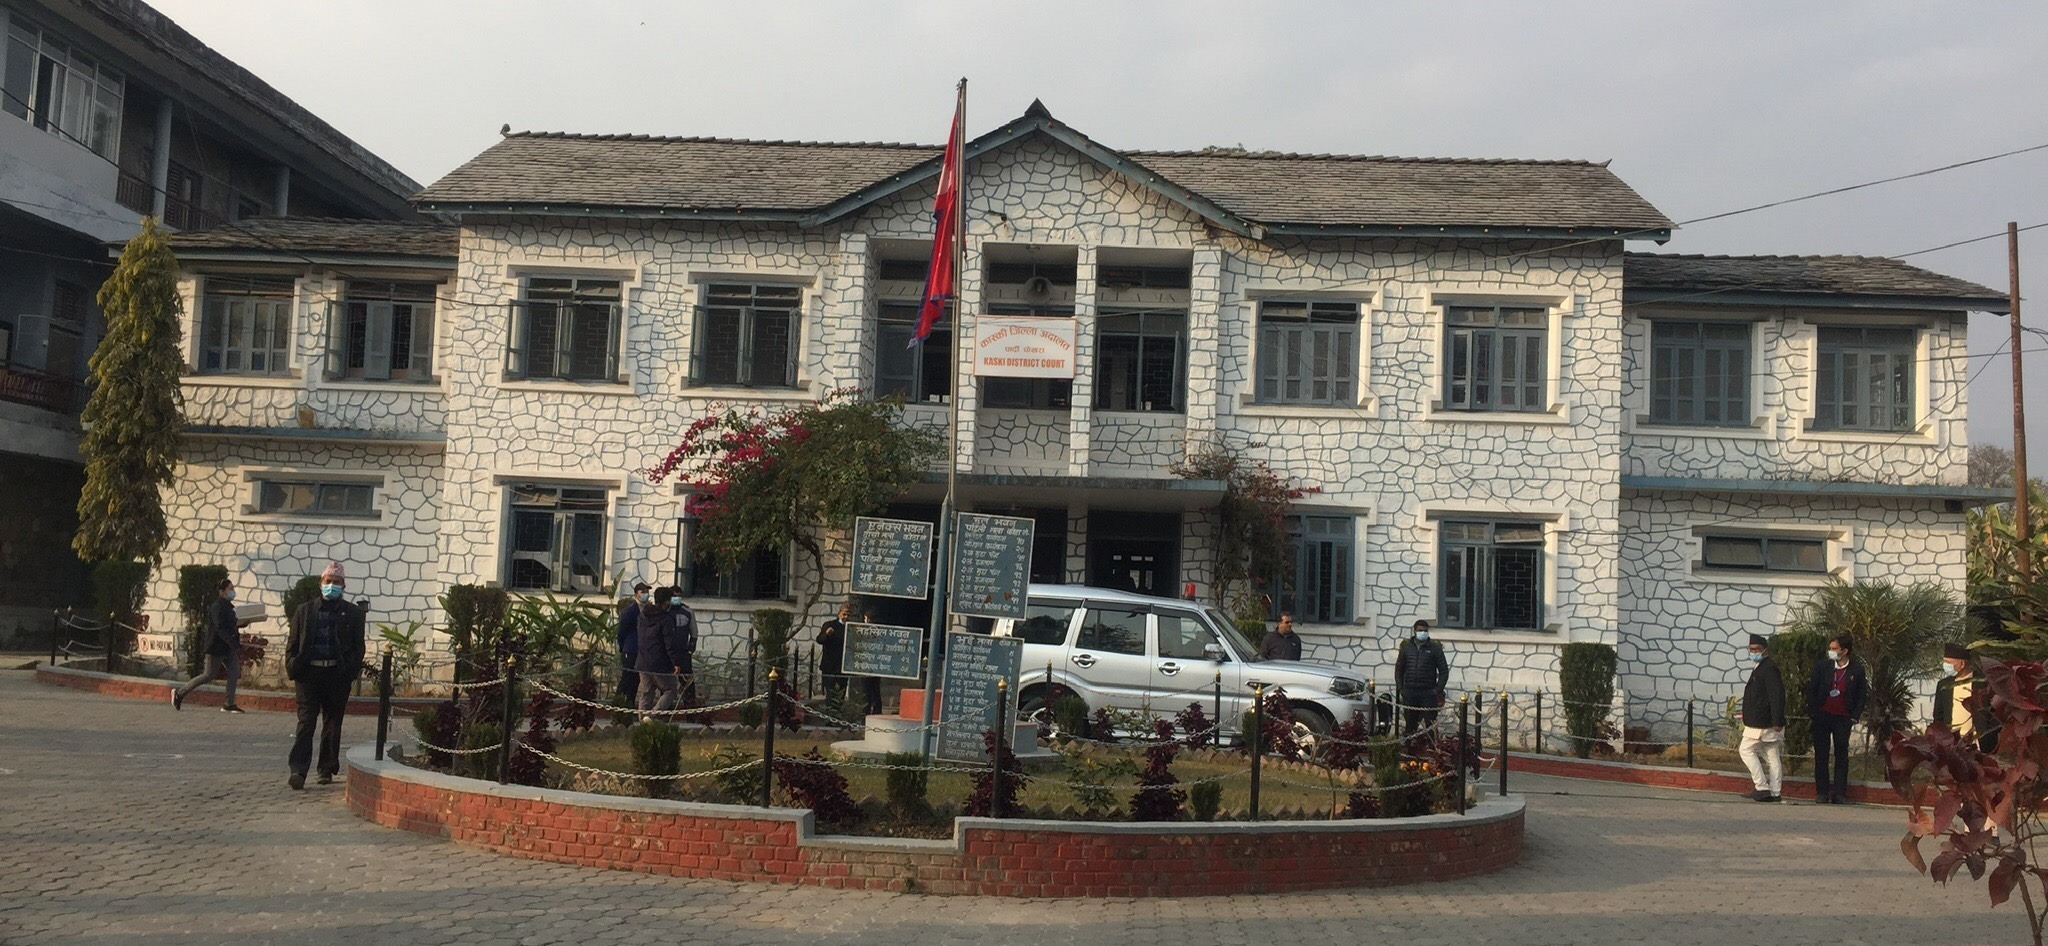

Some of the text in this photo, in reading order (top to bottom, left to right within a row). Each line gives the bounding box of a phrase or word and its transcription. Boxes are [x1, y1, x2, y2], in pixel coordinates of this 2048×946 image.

[981, 325, 1070, 351] कास्की जिल्ला अदालत
[984, 357, 1065, 368] KASKI DISTRICT COURT
[904, 524, 925, 534] भवन
[910, 551, 922, 559] २०
[889, 629, 910, 638] भवन
[156, 640, 173, 651] PARKING
